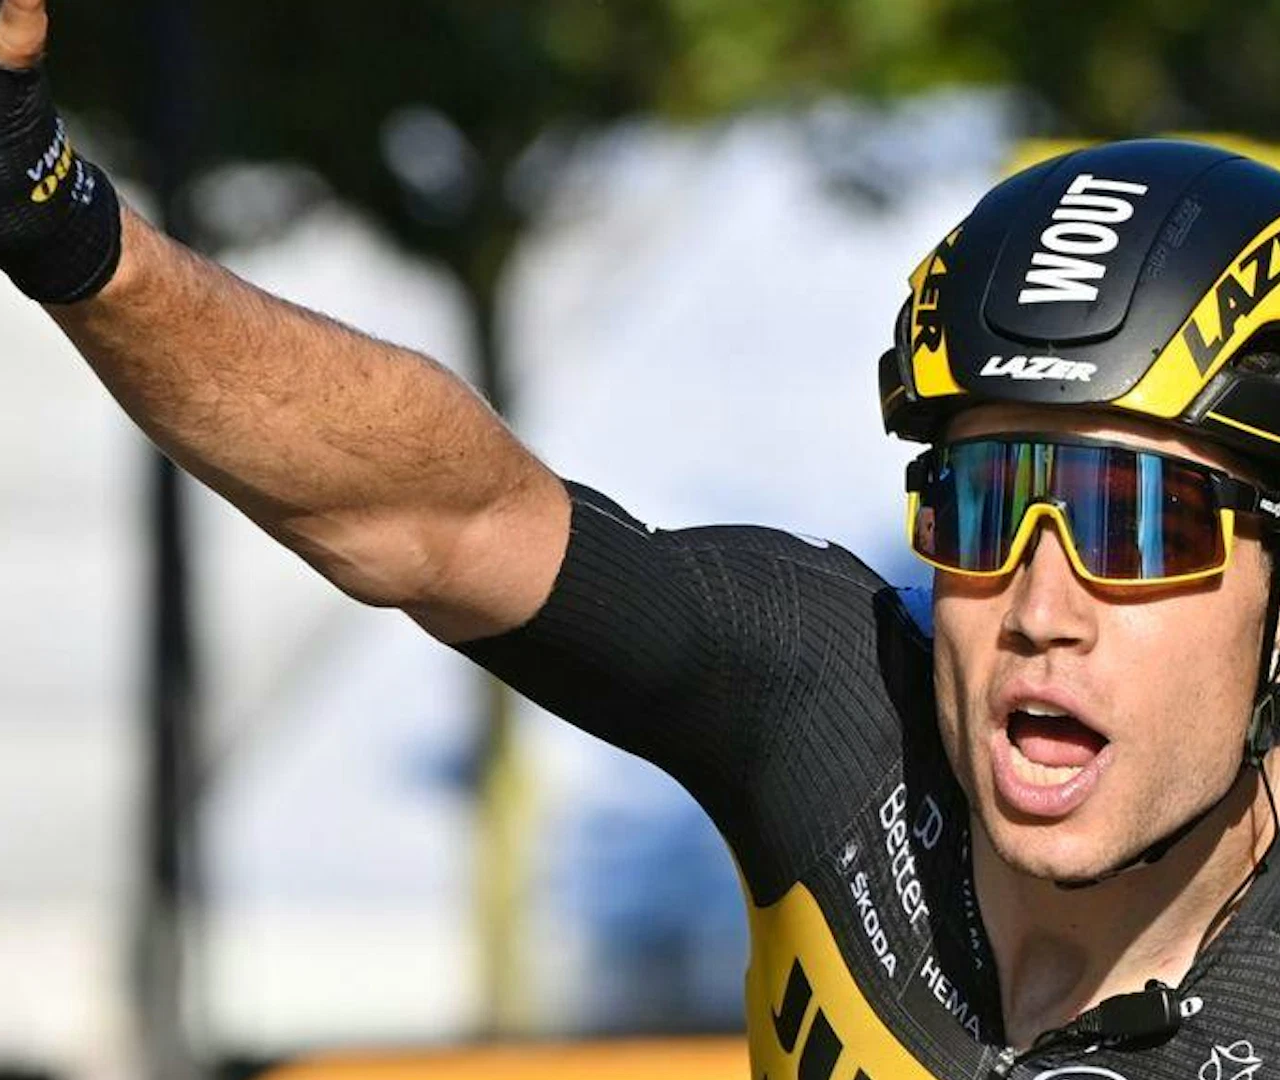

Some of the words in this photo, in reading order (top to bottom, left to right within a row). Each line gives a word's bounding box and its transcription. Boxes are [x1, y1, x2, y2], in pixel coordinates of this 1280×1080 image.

[1017, 173, 1149, 305] WOUT
[979, 355, 1098, 382] LAZER
[879, 782, 930, 924] Better
[919, 955, 982, 1042] HEMA
